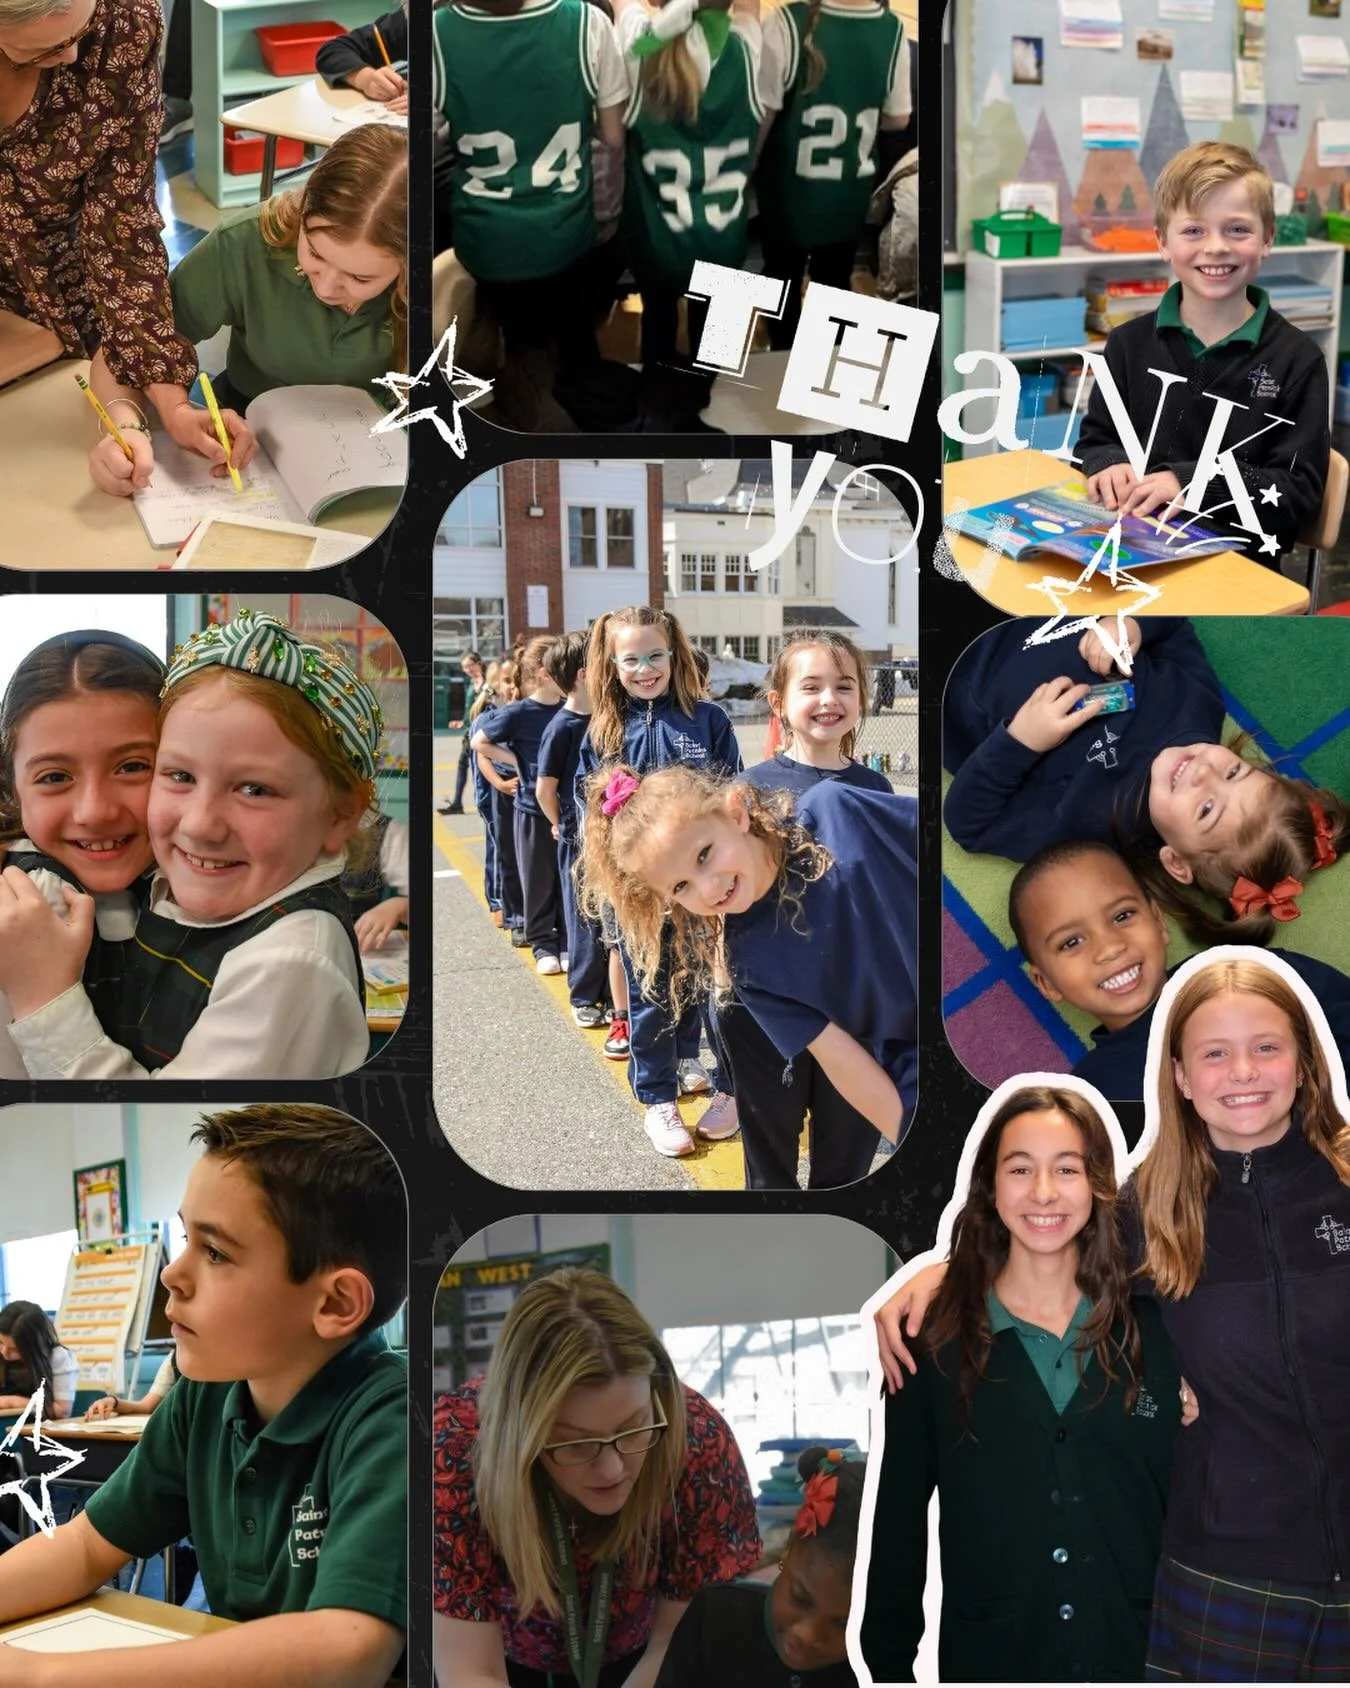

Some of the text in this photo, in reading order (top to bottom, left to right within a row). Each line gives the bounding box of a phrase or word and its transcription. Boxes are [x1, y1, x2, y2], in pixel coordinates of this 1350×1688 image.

[456, 121, 583, 199] 24
[796, 103, 880, 180] 21
[642, 137, 750, 233] 35
[476, 1263, 532, 1284] WEST
